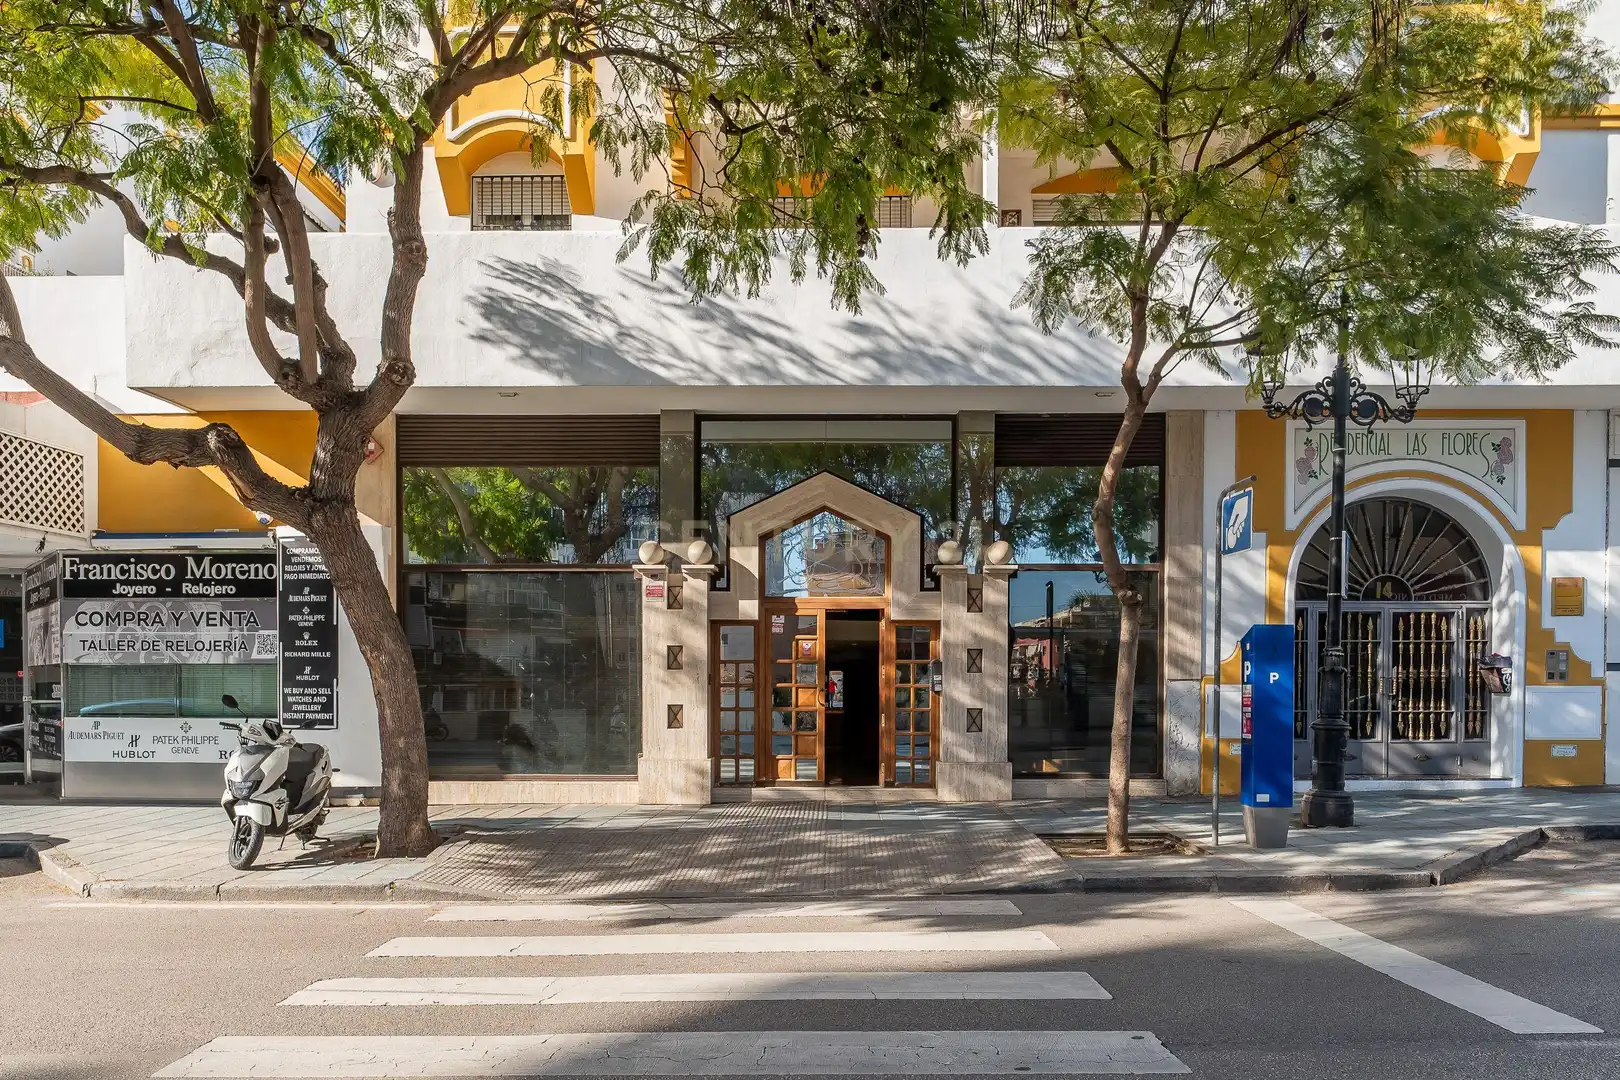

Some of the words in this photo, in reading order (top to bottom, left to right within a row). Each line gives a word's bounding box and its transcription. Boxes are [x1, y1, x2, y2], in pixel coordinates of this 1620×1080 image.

[1406, 432, 1428, 456] LAS
[1441, 432, 1491, 479] FLORES
[286, 547, 321, 555] COMPRAMO
[63, 557, 176, 580] Francisco
[185, 556, 277, 580] Moreno
[284, 564, 306, 572] RELOJES
[311, 564, 328, 572] JOYA
[112, 582, 157, 597] Joyero
[182, 582, 236, 597] Relojero
[1375, 581, 1393, 599] 14
[74, 610, 165, 628] COMPRA
[169, 610, 184, 627] Y
[189, 610, 261, 628] VENTA
[79, 639, 136, 652] TALLER
[140, 639, 161, 652] DE
[165, 636, 249, 652] RELOJERÍA
[1244, 661, 1251, 683] P
[1269, 672, 1280, 684] P
[318, 687, 332, 695] SELL
[68, 731, 102, 740] AUDEMARS
[102, 731, 125, 741] PIGUET
[152, 735, 180, 745] PATEK
[181, 735, 220, 745] PHILIPPE
[112, 750, 157, 759] HUBLOT
